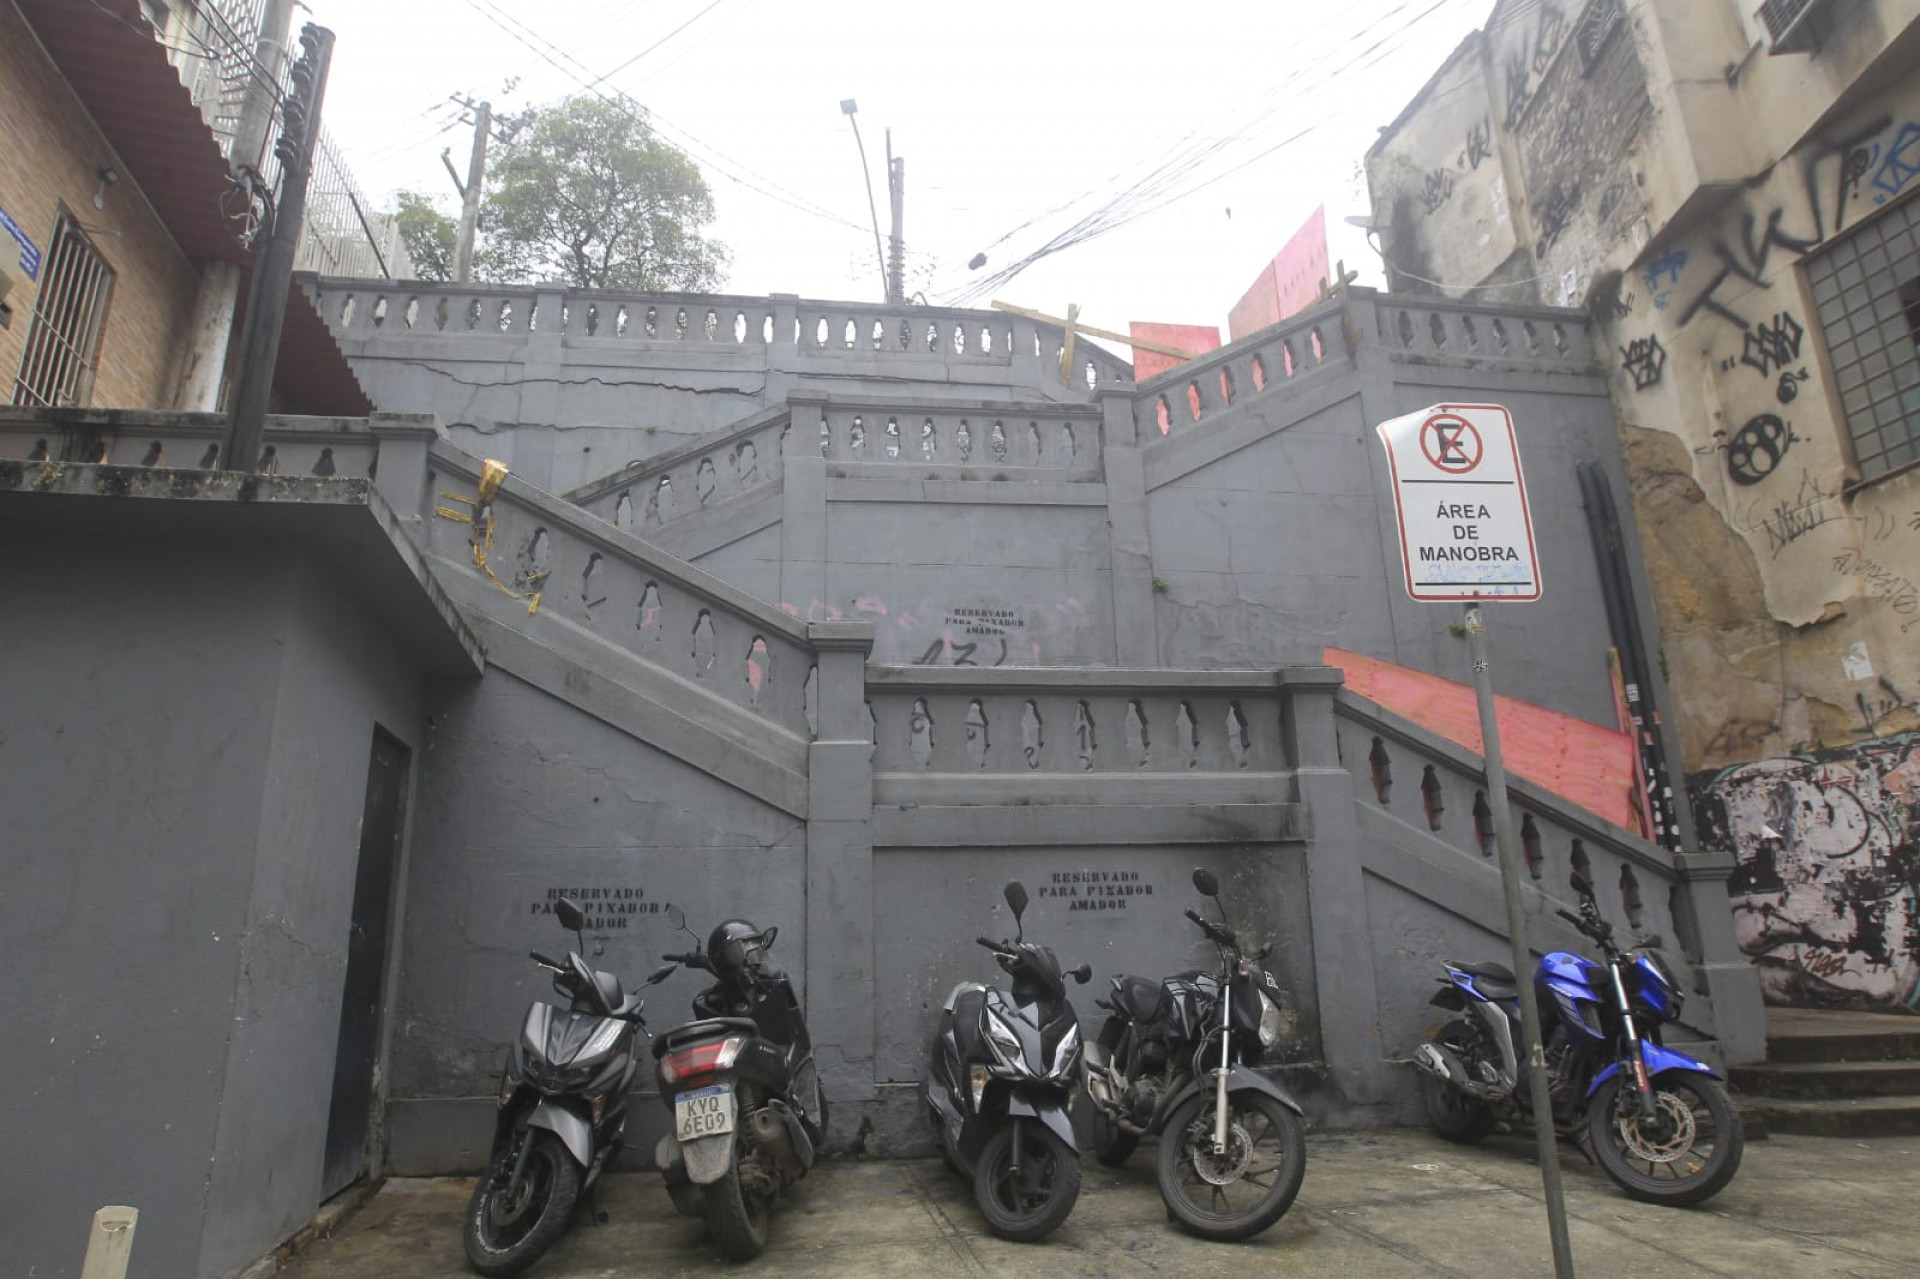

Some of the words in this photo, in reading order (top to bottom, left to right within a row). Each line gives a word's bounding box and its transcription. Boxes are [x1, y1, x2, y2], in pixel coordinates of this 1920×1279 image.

[1436, 500, 1491, 519] ÁREA
[1453, 525, 1480, 541] DE
[1419, 546, 1519, 562] MANOBRA
[954, 608, 1015, 618] RESERVADO
[1052, 872, 1139, 883] RESERVADO
[548, 888, 644, 899] RESERVADO
[1039, 887, 1078, 898] PARA
[1087, 885, 1153, 896] PIXADOR
[585, 902, 659, 914] PIXADOR
[1070, 900, 1127, 911] AMADOR
[585, 917, 627, 928] ADOR
[688, 1097, 719, 1117] KYQ
